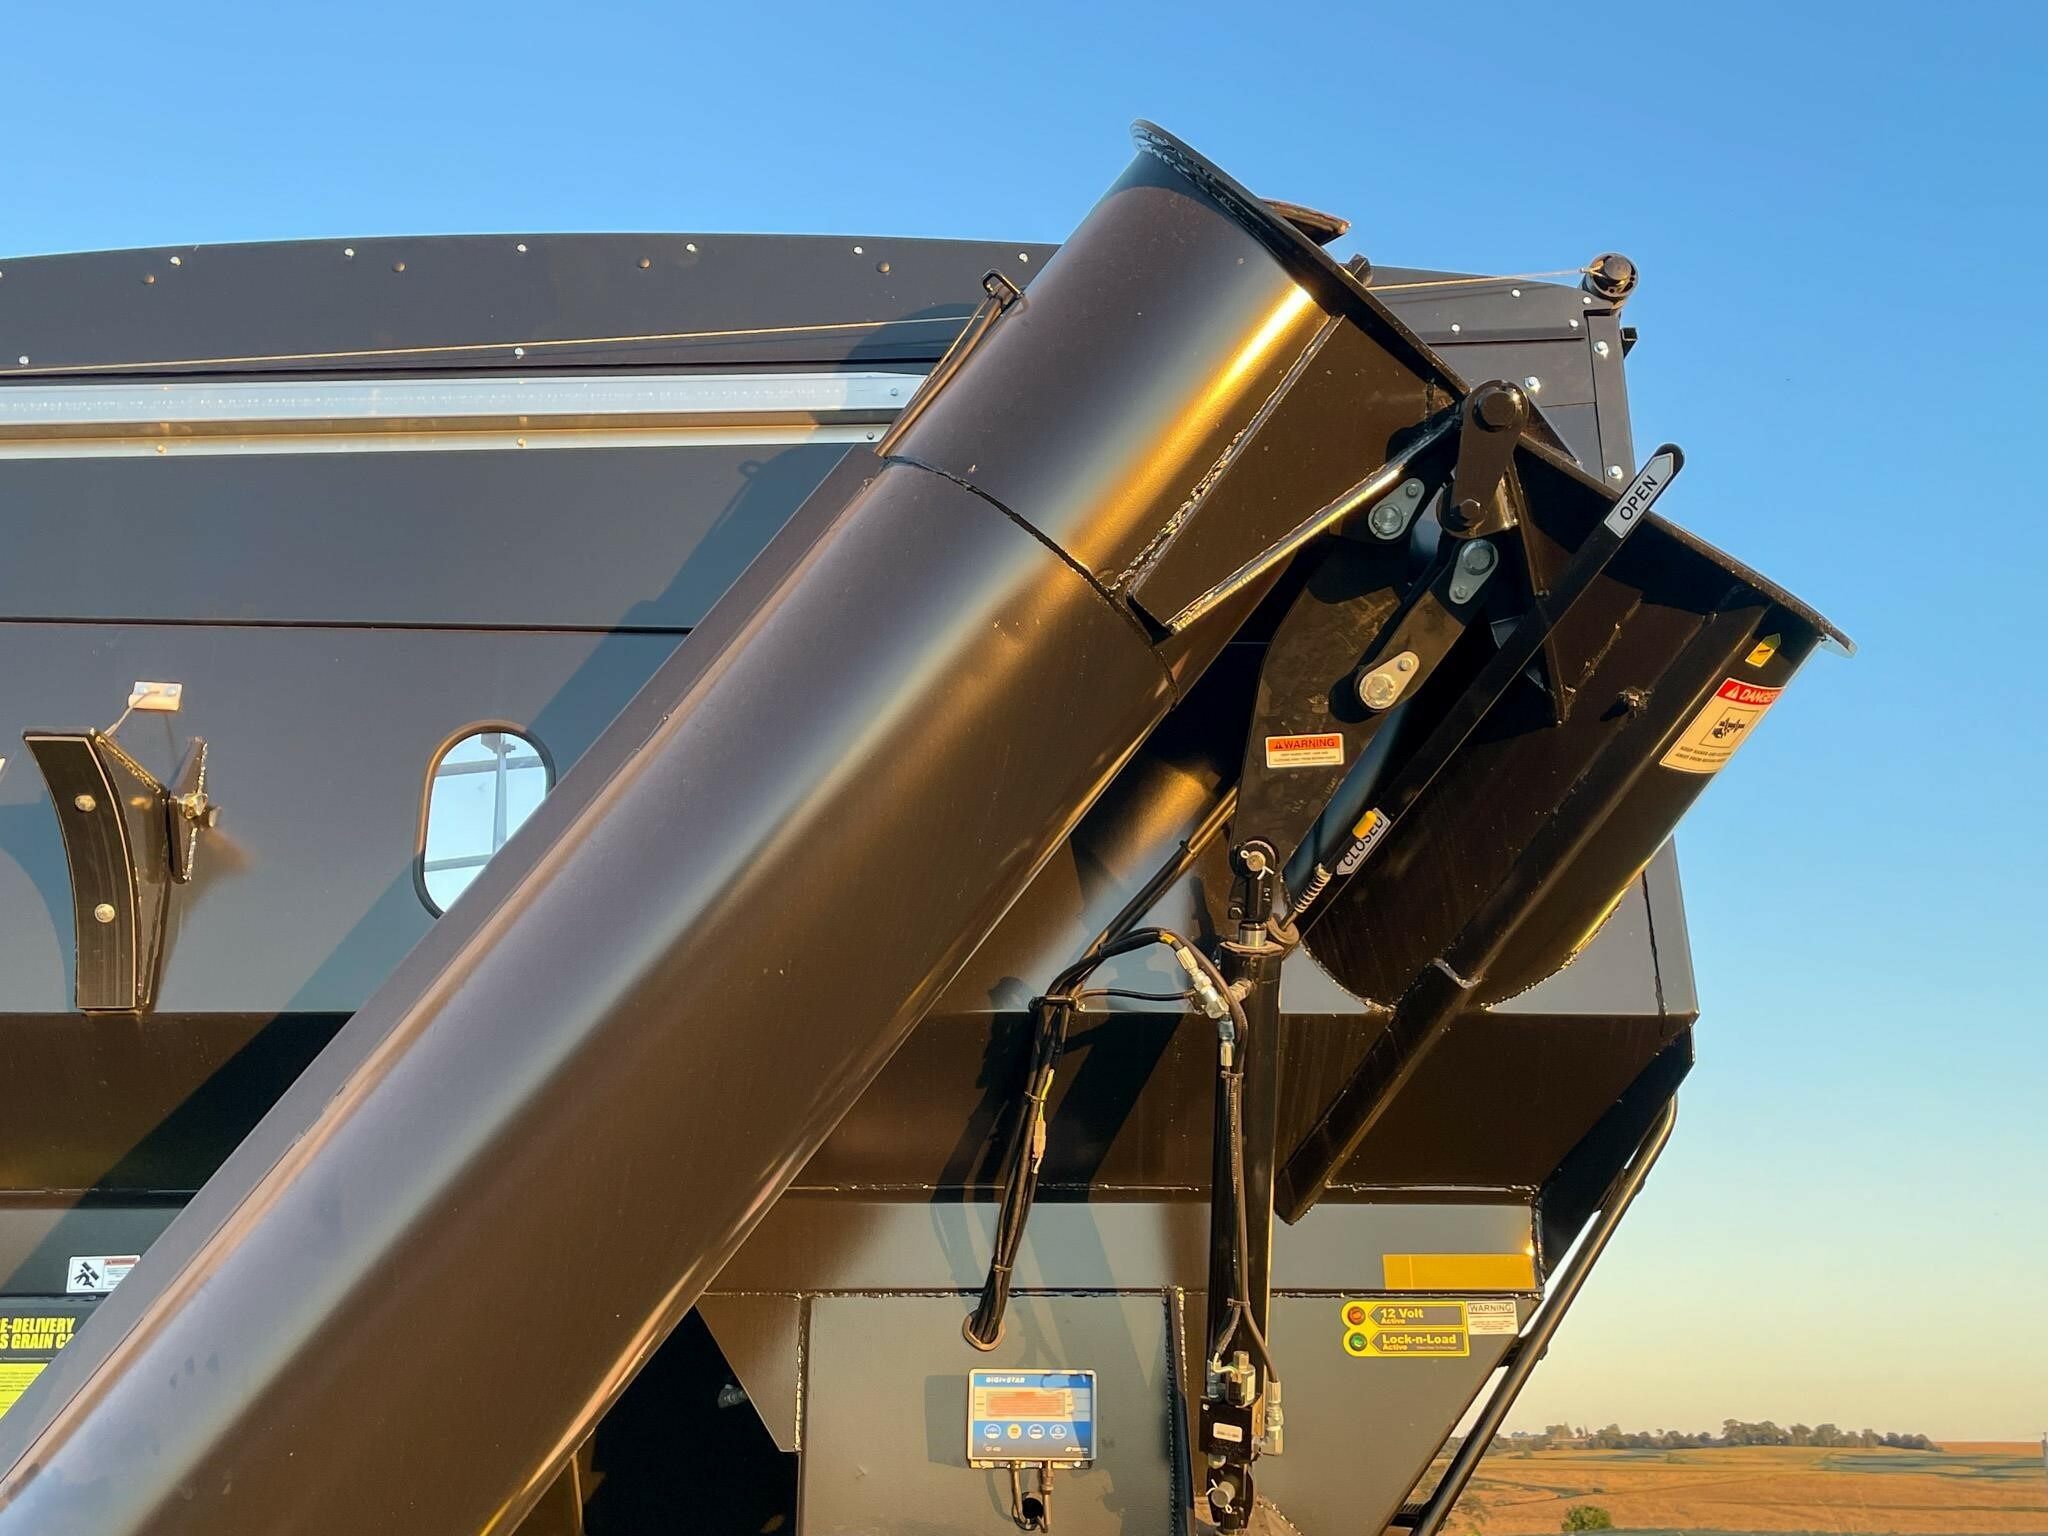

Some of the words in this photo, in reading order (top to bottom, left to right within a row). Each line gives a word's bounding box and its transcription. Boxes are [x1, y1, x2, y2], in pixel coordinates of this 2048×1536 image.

[1620, 475, 1658, 520] OPEN
[1284, 738, 1335, 749] WARNING
[1380, 1308, 1395, 1319] 12
[1399, 1308, 1424, 1319] Volt
[1469, 1303, 1513, 1313] WARNING
[1381, 1317, 1406, 1325] Active
[11, 1333, 54, 1349] GRAIN
[1382, 1333, 1457, 1344] Lock-n-Load
